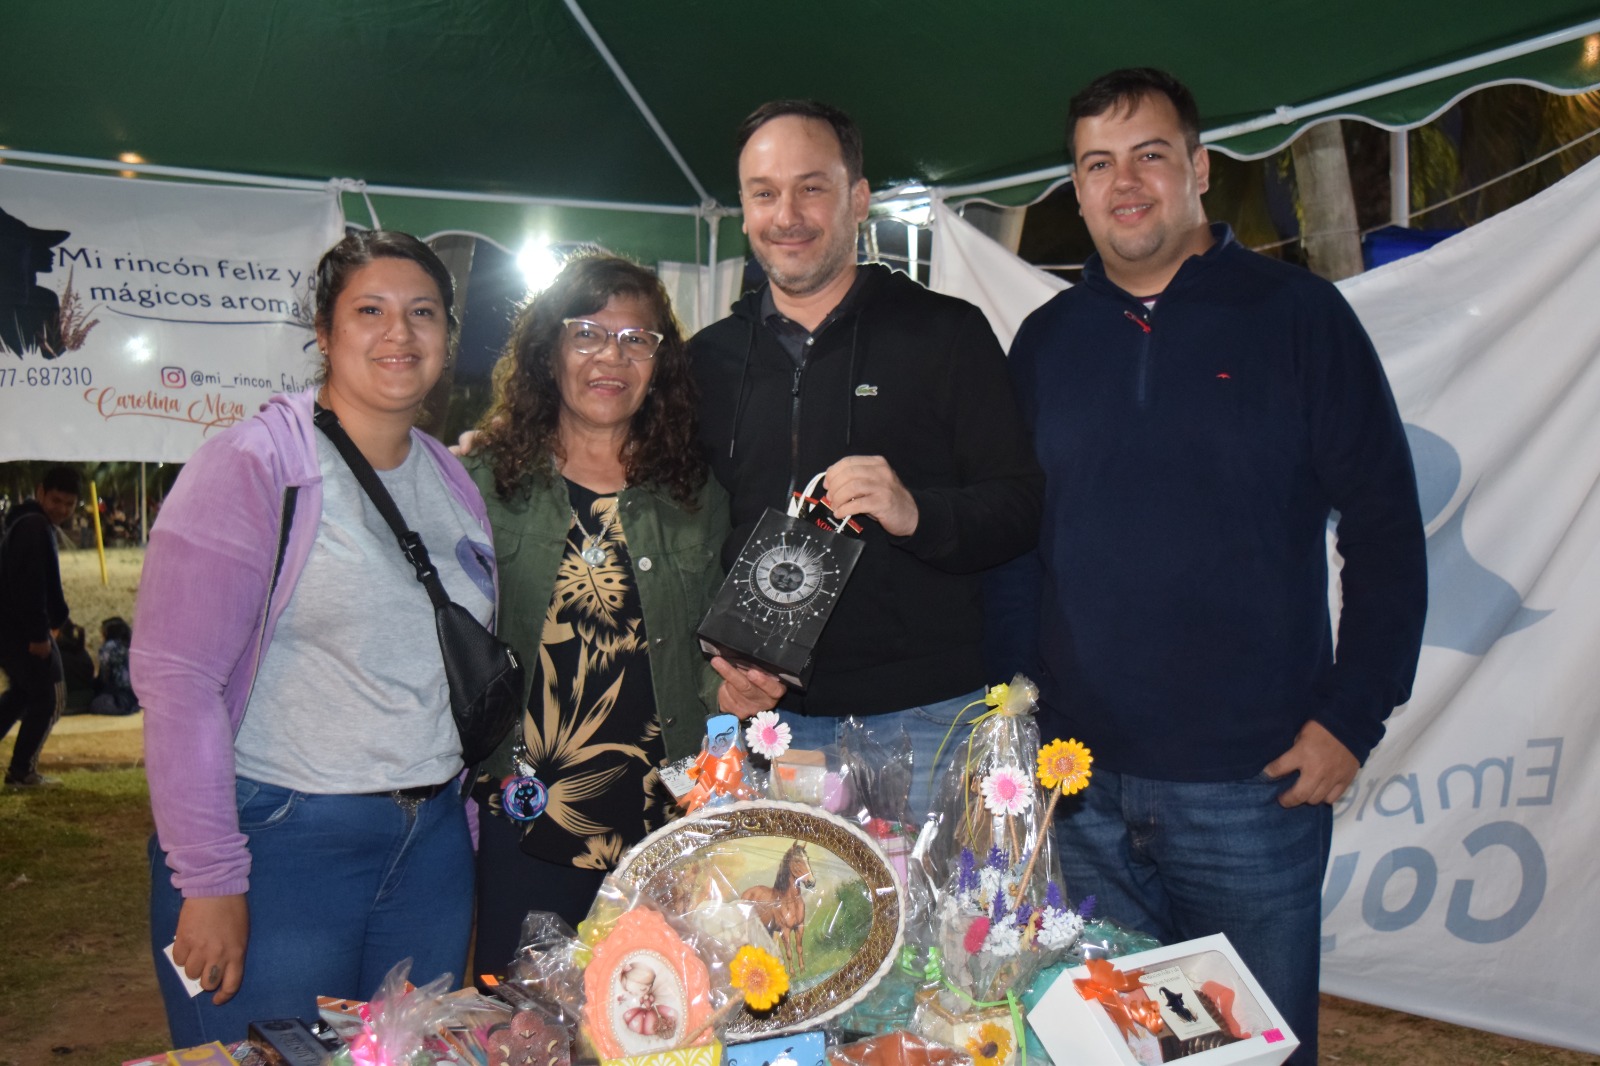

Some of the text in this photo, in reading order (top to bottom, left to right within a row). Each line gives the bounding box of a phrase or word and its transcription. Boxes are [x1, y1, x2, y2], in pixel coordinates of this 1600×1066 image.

[58, 247, 102, 269] Mi
[115, 252, 209, 278] rincón
[217, 260, 281, 282] feliz
[288, 269, 301, 287] y
[90, 283, 212, 309] mágicos
[0, 367, 92, 388] 77-687310
[83, 386, 180, 422] Carolina
